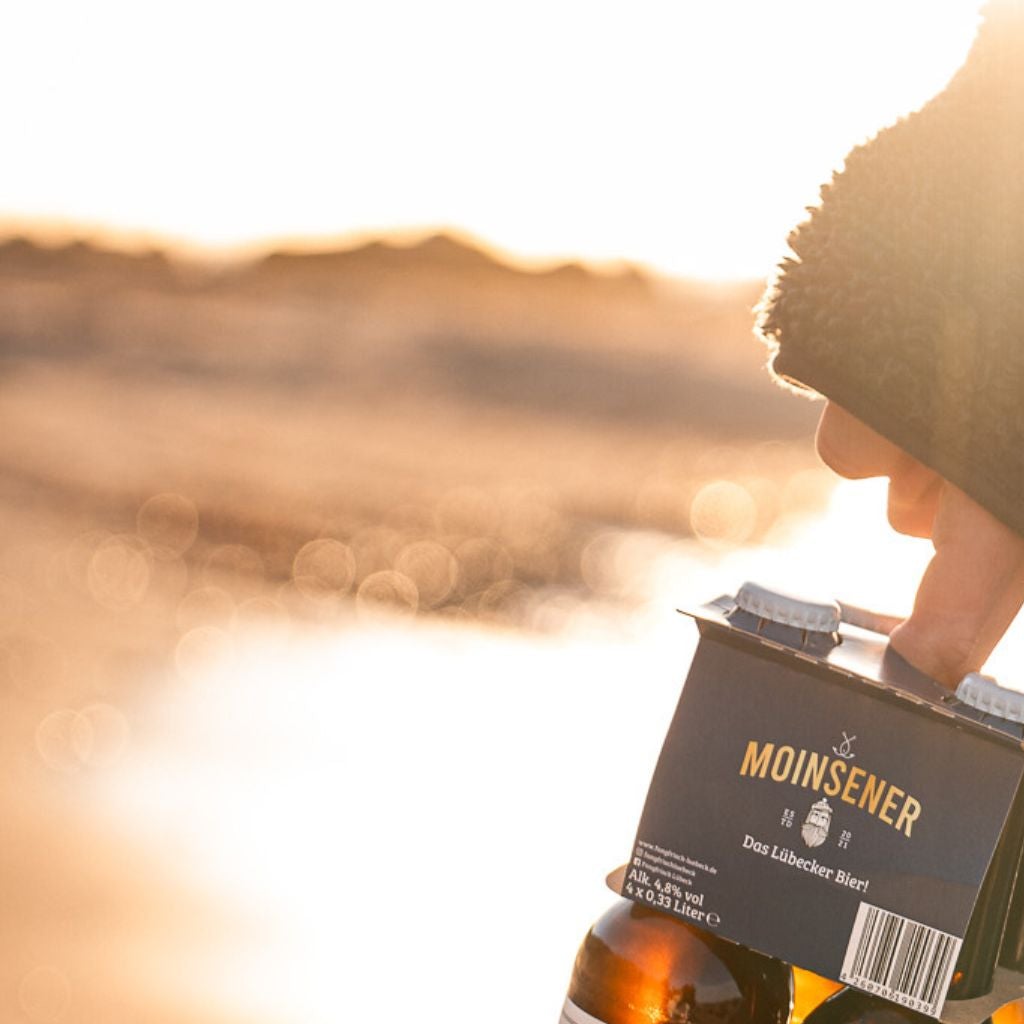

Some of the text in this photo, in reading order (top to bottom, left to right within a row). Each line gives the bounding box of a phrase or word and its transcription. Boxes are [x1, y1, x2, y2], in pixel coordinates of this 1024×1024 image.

[739, 741, 922, 838] MOINSENER
[838, 840, 849, 849] 21
[841, 830, 852, 840] 20
[742, 835, 870, 893] Das Lübecker Bier!
[626, 882, 634, 894] 4
[635, 887, 644, 898] x
[646, 889, 672, 909] 0,33
[673, 899, 706, 921] Liter
[628, 869, 651, 886] Alk.
[685, 891, 705, 907] vol
